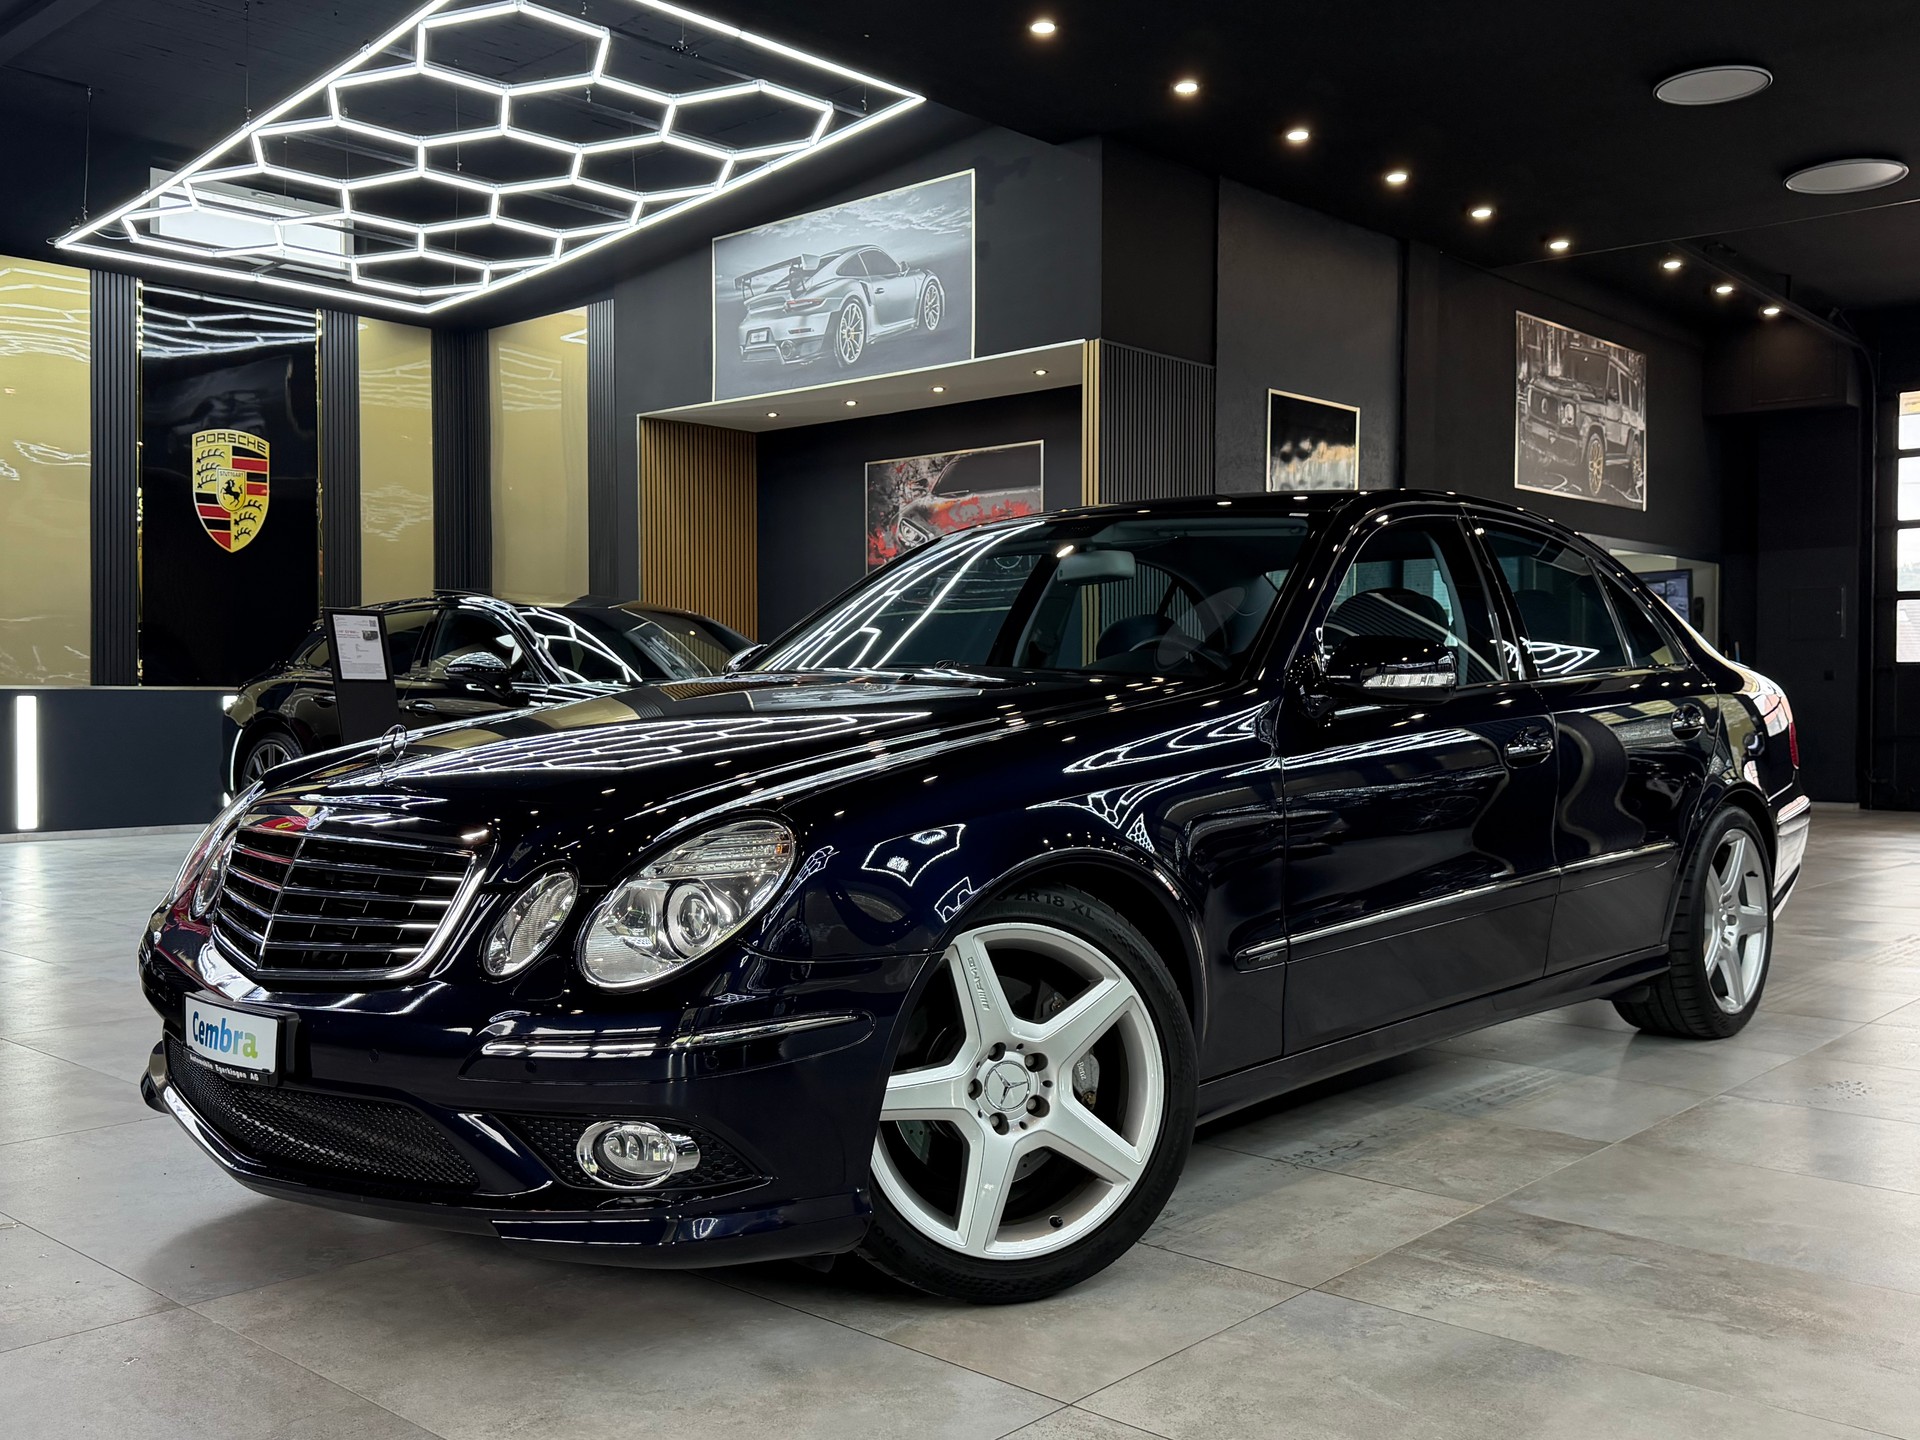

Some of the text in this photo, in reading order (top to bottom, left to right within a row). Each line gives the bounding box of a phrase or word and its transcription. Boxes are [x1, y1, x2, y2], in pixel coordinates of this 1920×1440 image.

[195, 432, 267, 454] PORSCHE
[1072, 901, 1095, 921] XL
[192, 1011, 259, 1059] Cembra
[250, 1072, 259, 1082] AG
